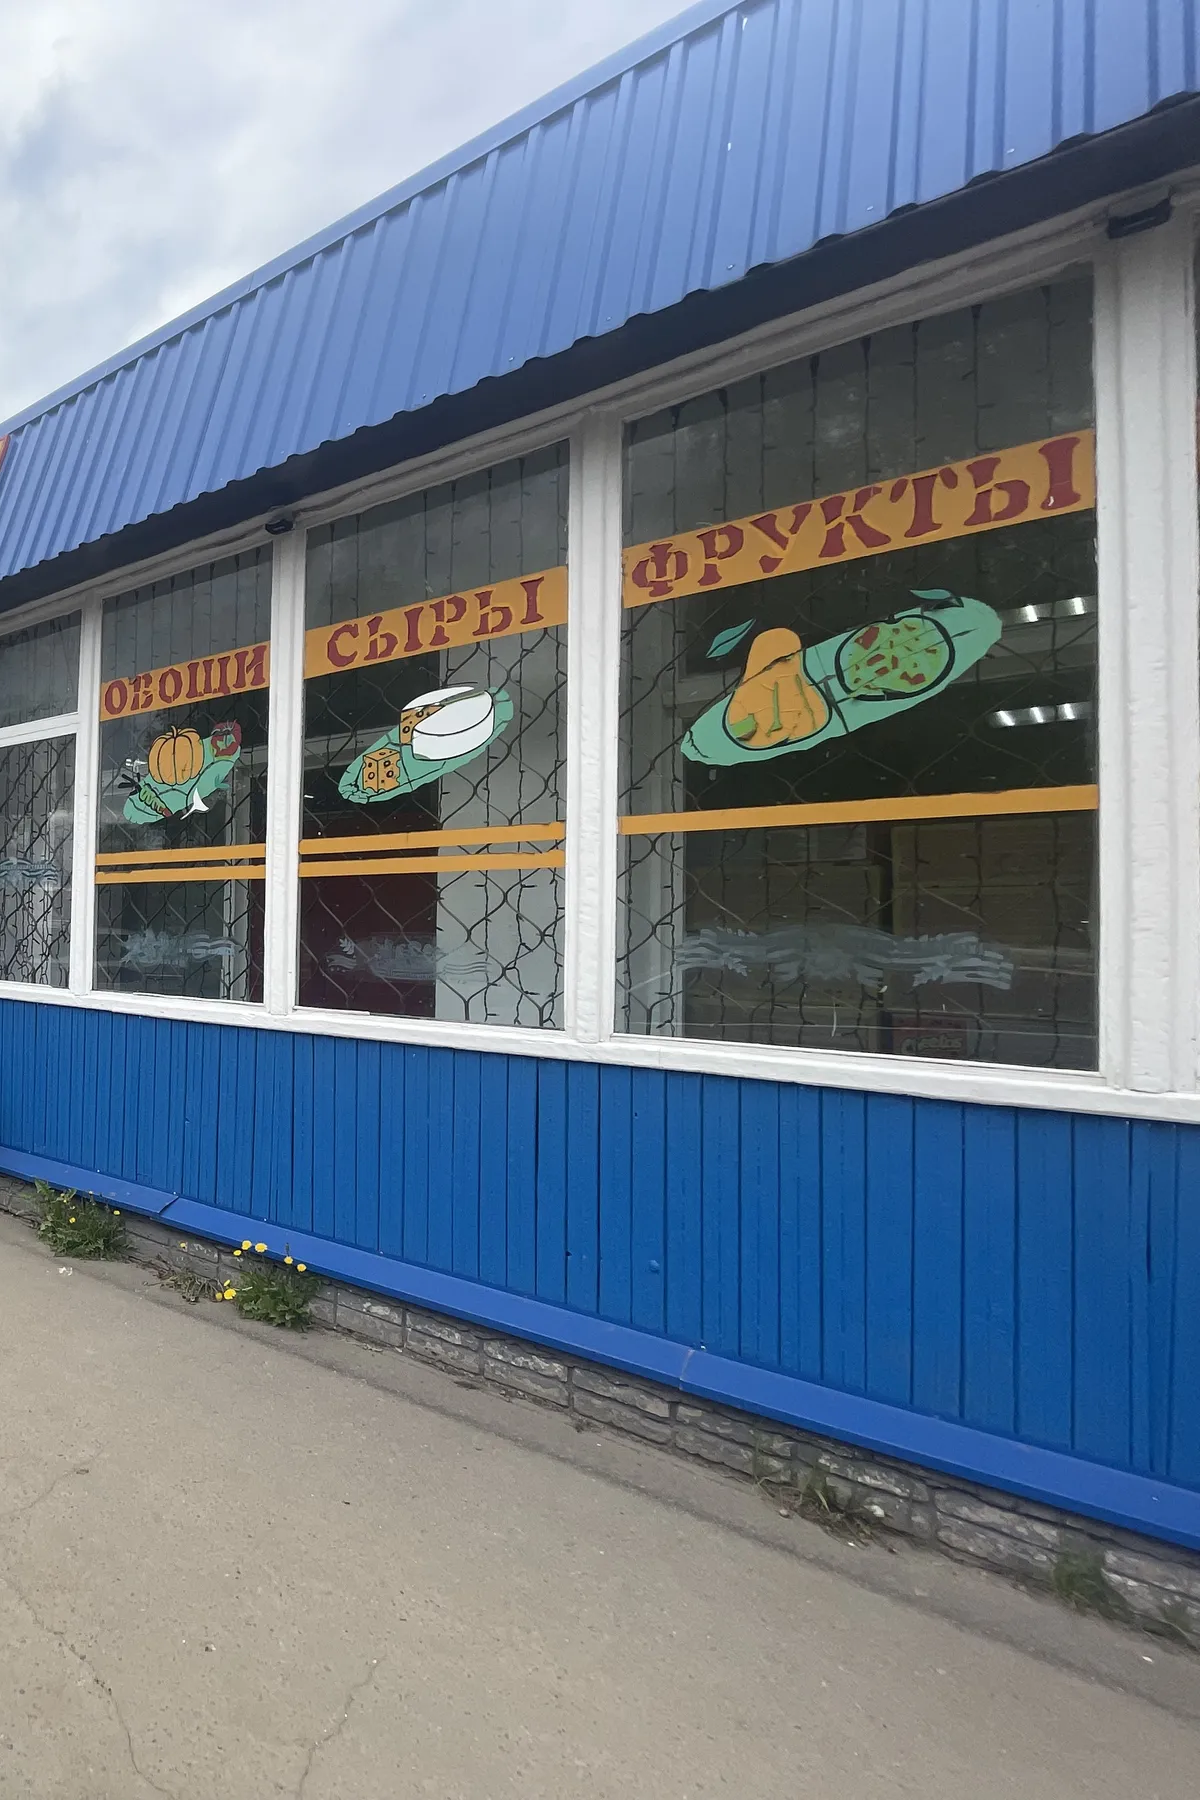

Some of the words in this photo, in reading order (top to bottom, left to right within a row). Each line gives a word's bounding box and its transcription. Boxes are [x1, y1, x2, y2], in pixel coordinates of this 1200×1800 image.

[632, 437, 1081, 597] ФРУКТЫ
[327, 576, 544, 667] СЫРЫ
[104, 645, 267, 716] ОВОЩИ
